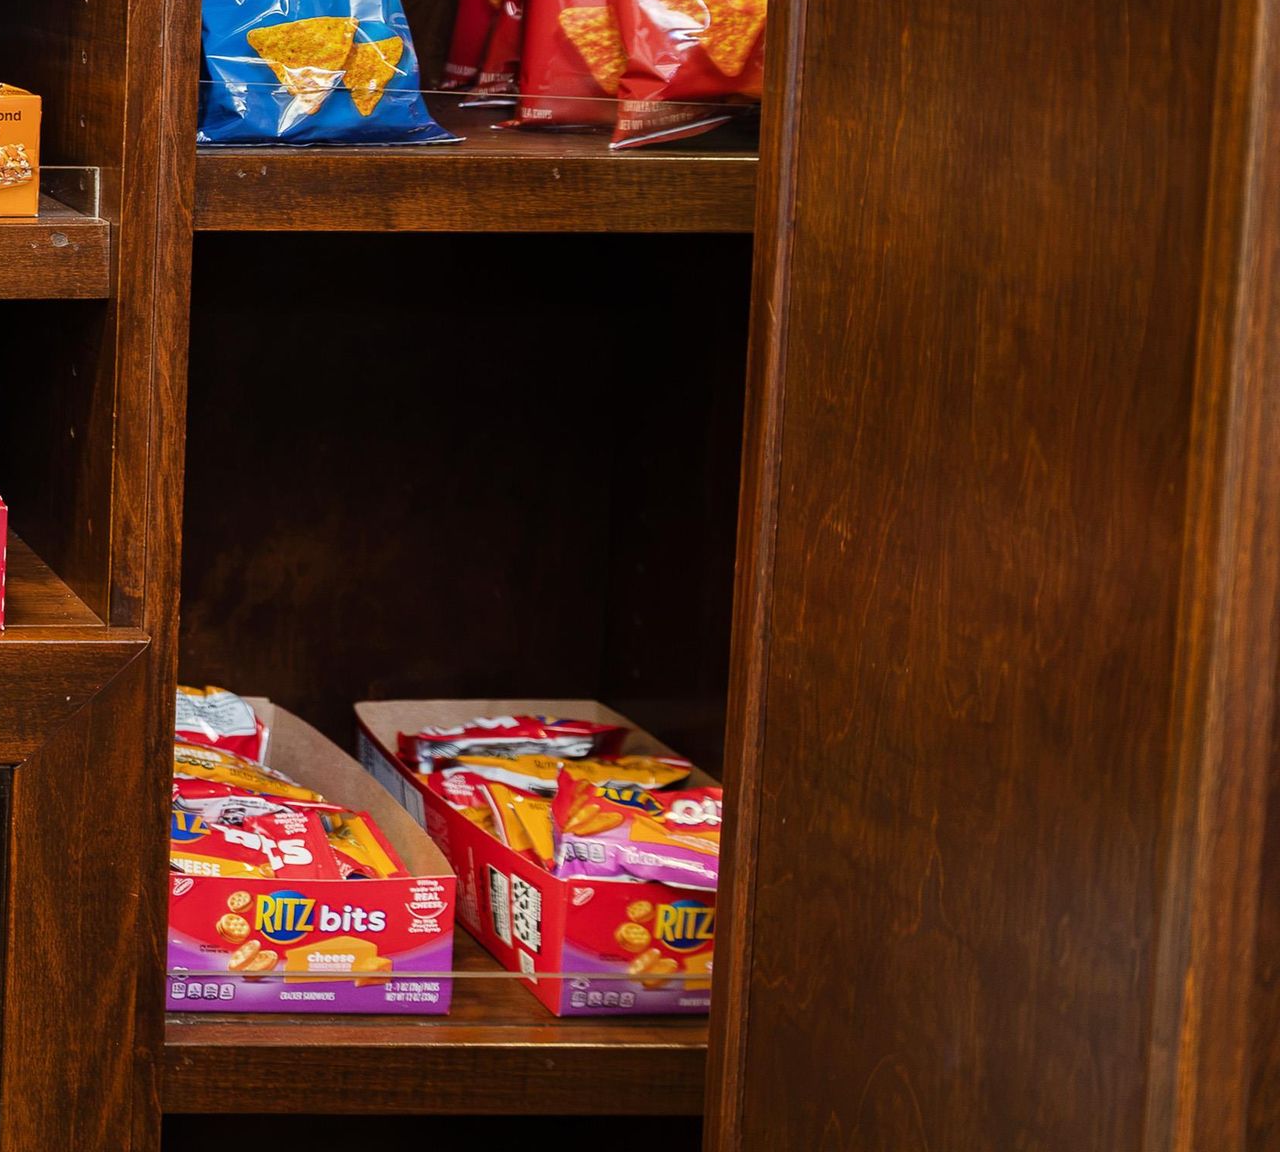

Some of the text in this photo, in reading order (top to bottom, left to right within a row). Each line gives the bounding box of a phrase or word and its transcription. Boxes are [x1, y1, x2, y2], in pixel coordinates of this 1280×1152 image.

[414, 893, 441, 901] REAL
[255, 894, 317, 934] RITZ
[319, 904, 387, 933] bits
[654, 904, 715, 941] RITZ
[307, 952, 356, 963] cheese
